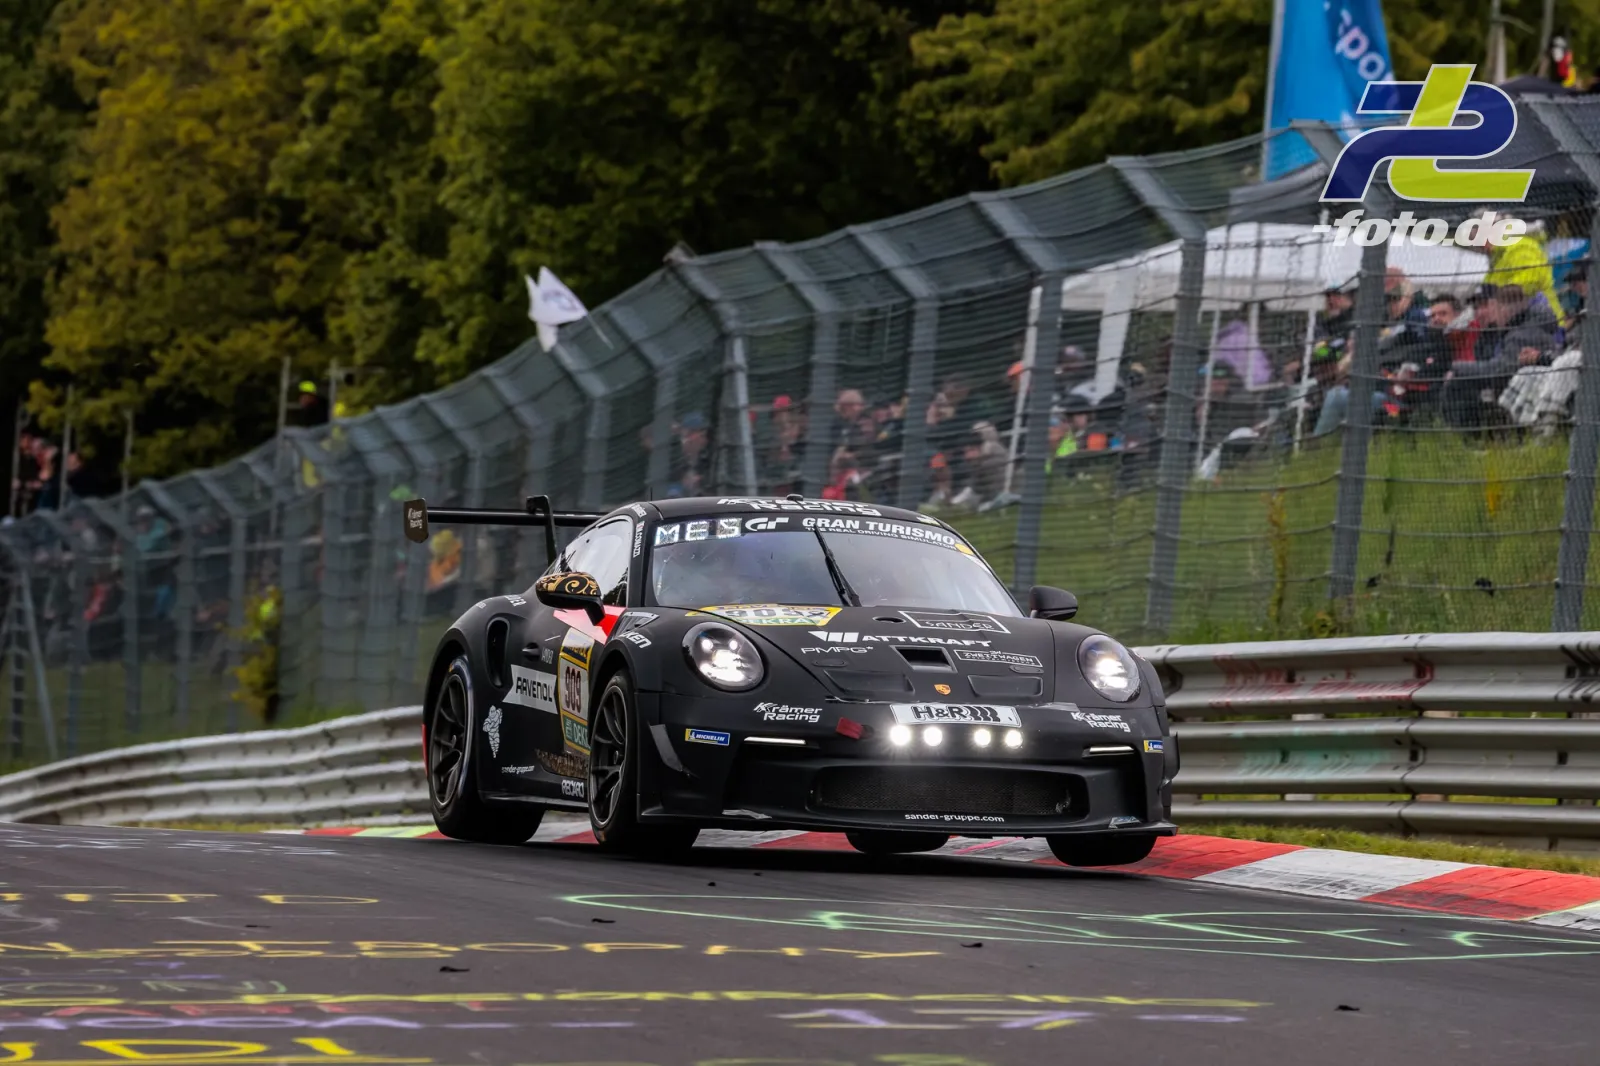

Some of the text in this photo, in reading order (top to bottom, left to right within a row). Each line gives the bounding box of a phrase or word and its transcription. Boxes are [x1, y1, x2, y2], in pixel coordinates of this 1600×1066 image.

[654, 518, 742, 546] MES
[802, 517, 956, 546] GRAN TURISMO
[828, 527, 857, 535] REAL
[857, 529, 899, 538] DRIVING
[516, 676, 553, 703] RAVENOL
[565, 666, 582, 714] 909
[753, 702, 823, 714] Krämer
[763, 712, 821, 723] Racing
[1070, 712, 1123, 722] Krämer
[1087, 720, 1131, 733] Racing
[695, 733, 725, 742] MICHELIN
[904, 813, 1005, 822] sander-gruppe.com
